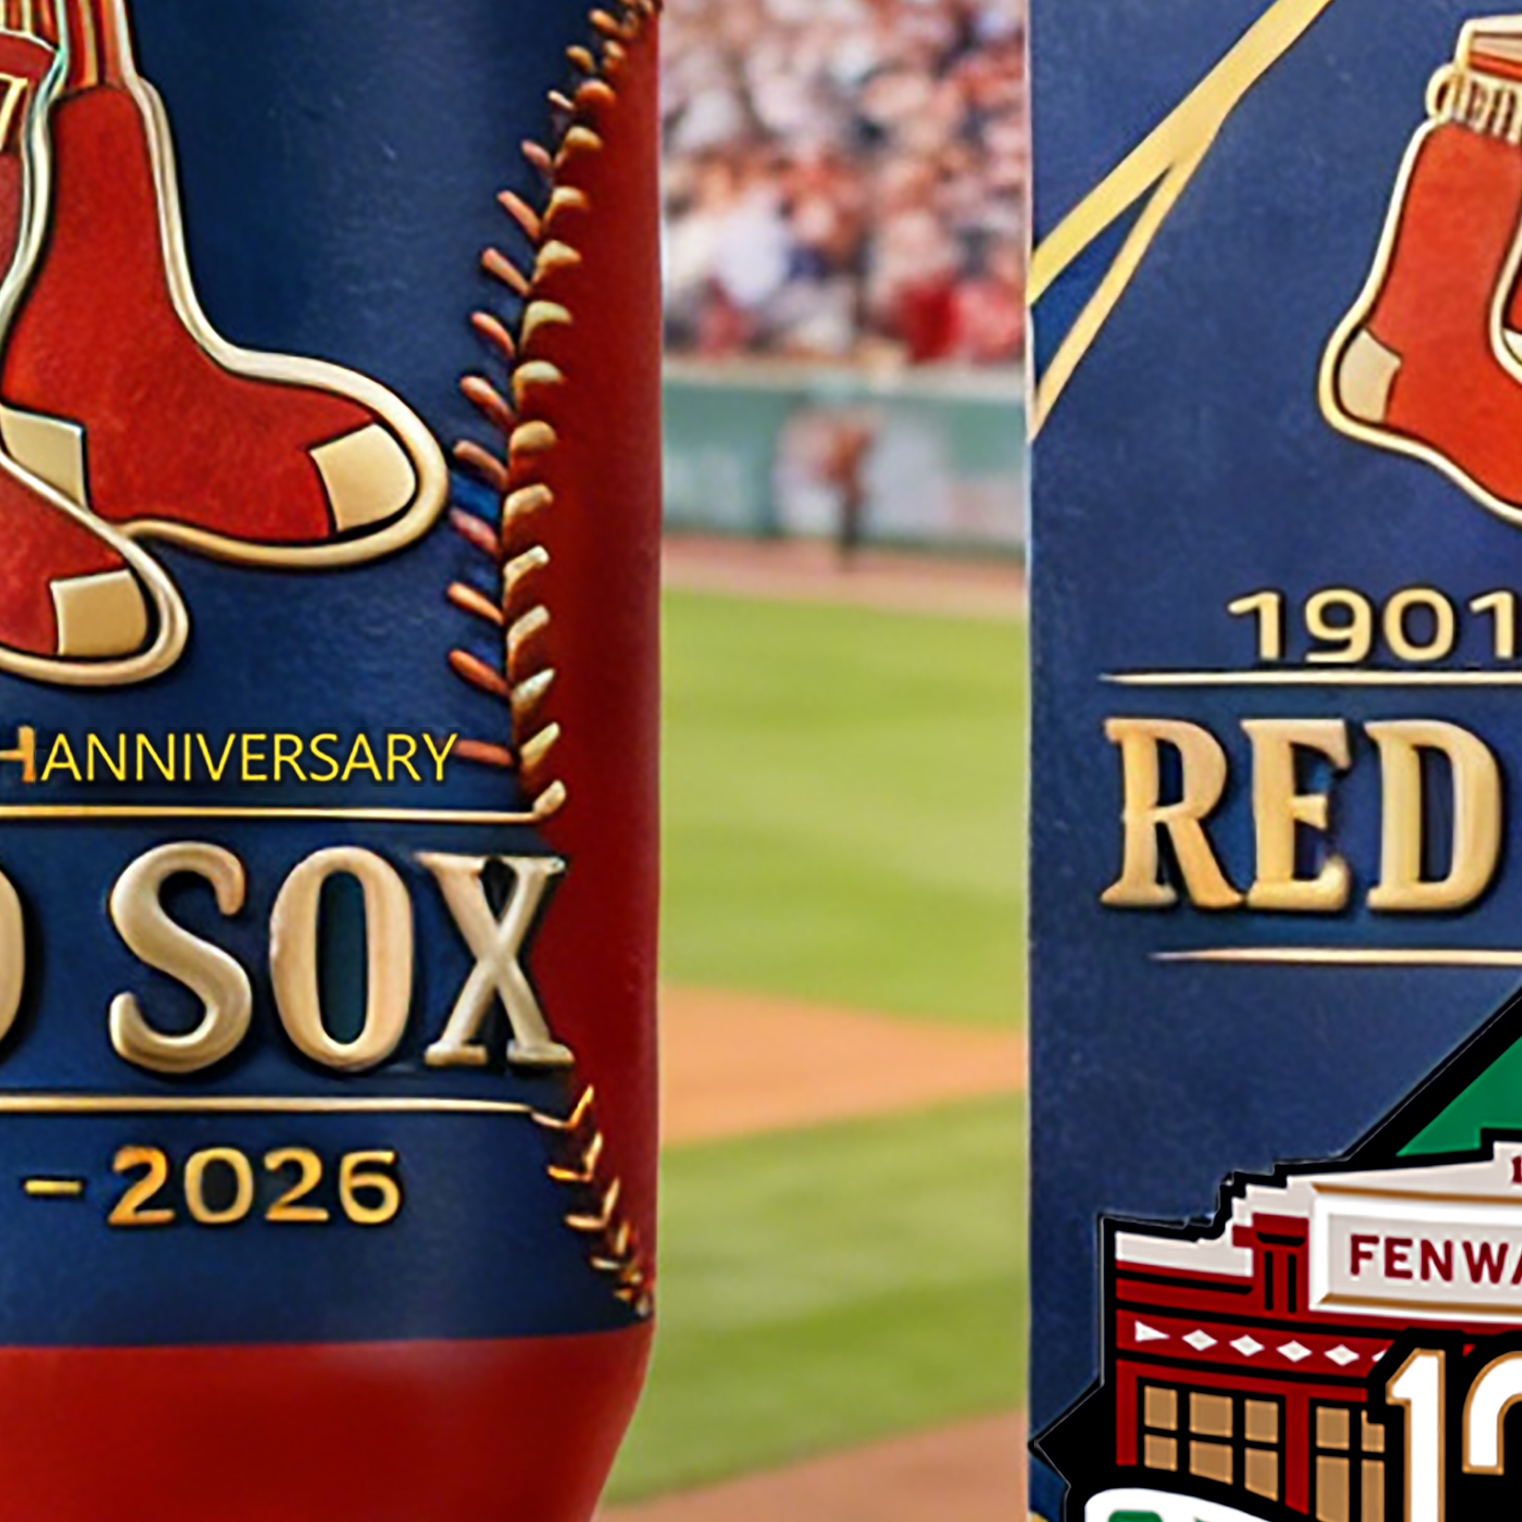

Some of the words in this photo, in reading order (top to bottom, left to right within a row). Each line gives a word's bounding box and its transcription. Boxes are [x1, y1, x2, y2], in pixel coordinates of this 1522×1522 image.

[1100, 717, 1504, 913] RED
[106, 840, 575, 1074] SOX
[106, 1143, 402, 1226] 2026
